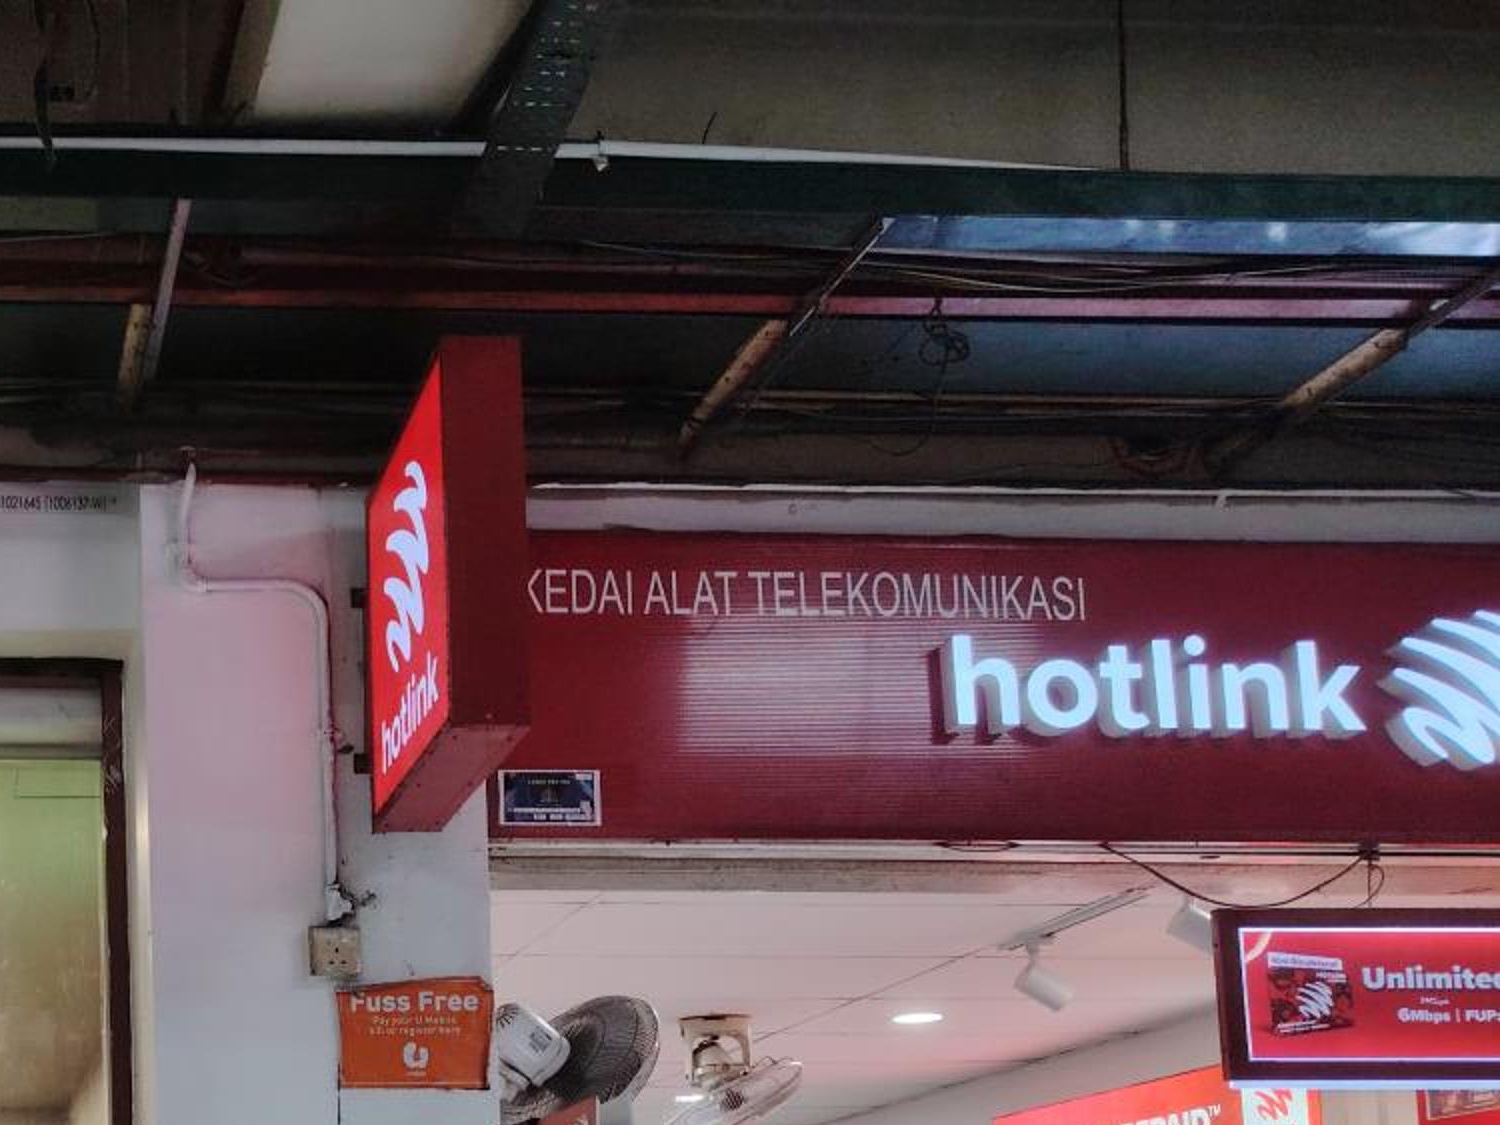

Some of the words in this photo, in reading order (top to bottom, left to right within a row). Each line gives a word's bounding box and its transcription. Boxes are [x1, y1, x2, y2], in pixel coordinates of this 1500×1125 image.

[643, 570, 738, 616] ALAT
[747, 570, 1086, 621] TELEKOMUNIKASI
[380, 650, 440, 777] hotlink
[947, 633, 1369, 735] hotlink
[418, 990, 480, 1013] Free
